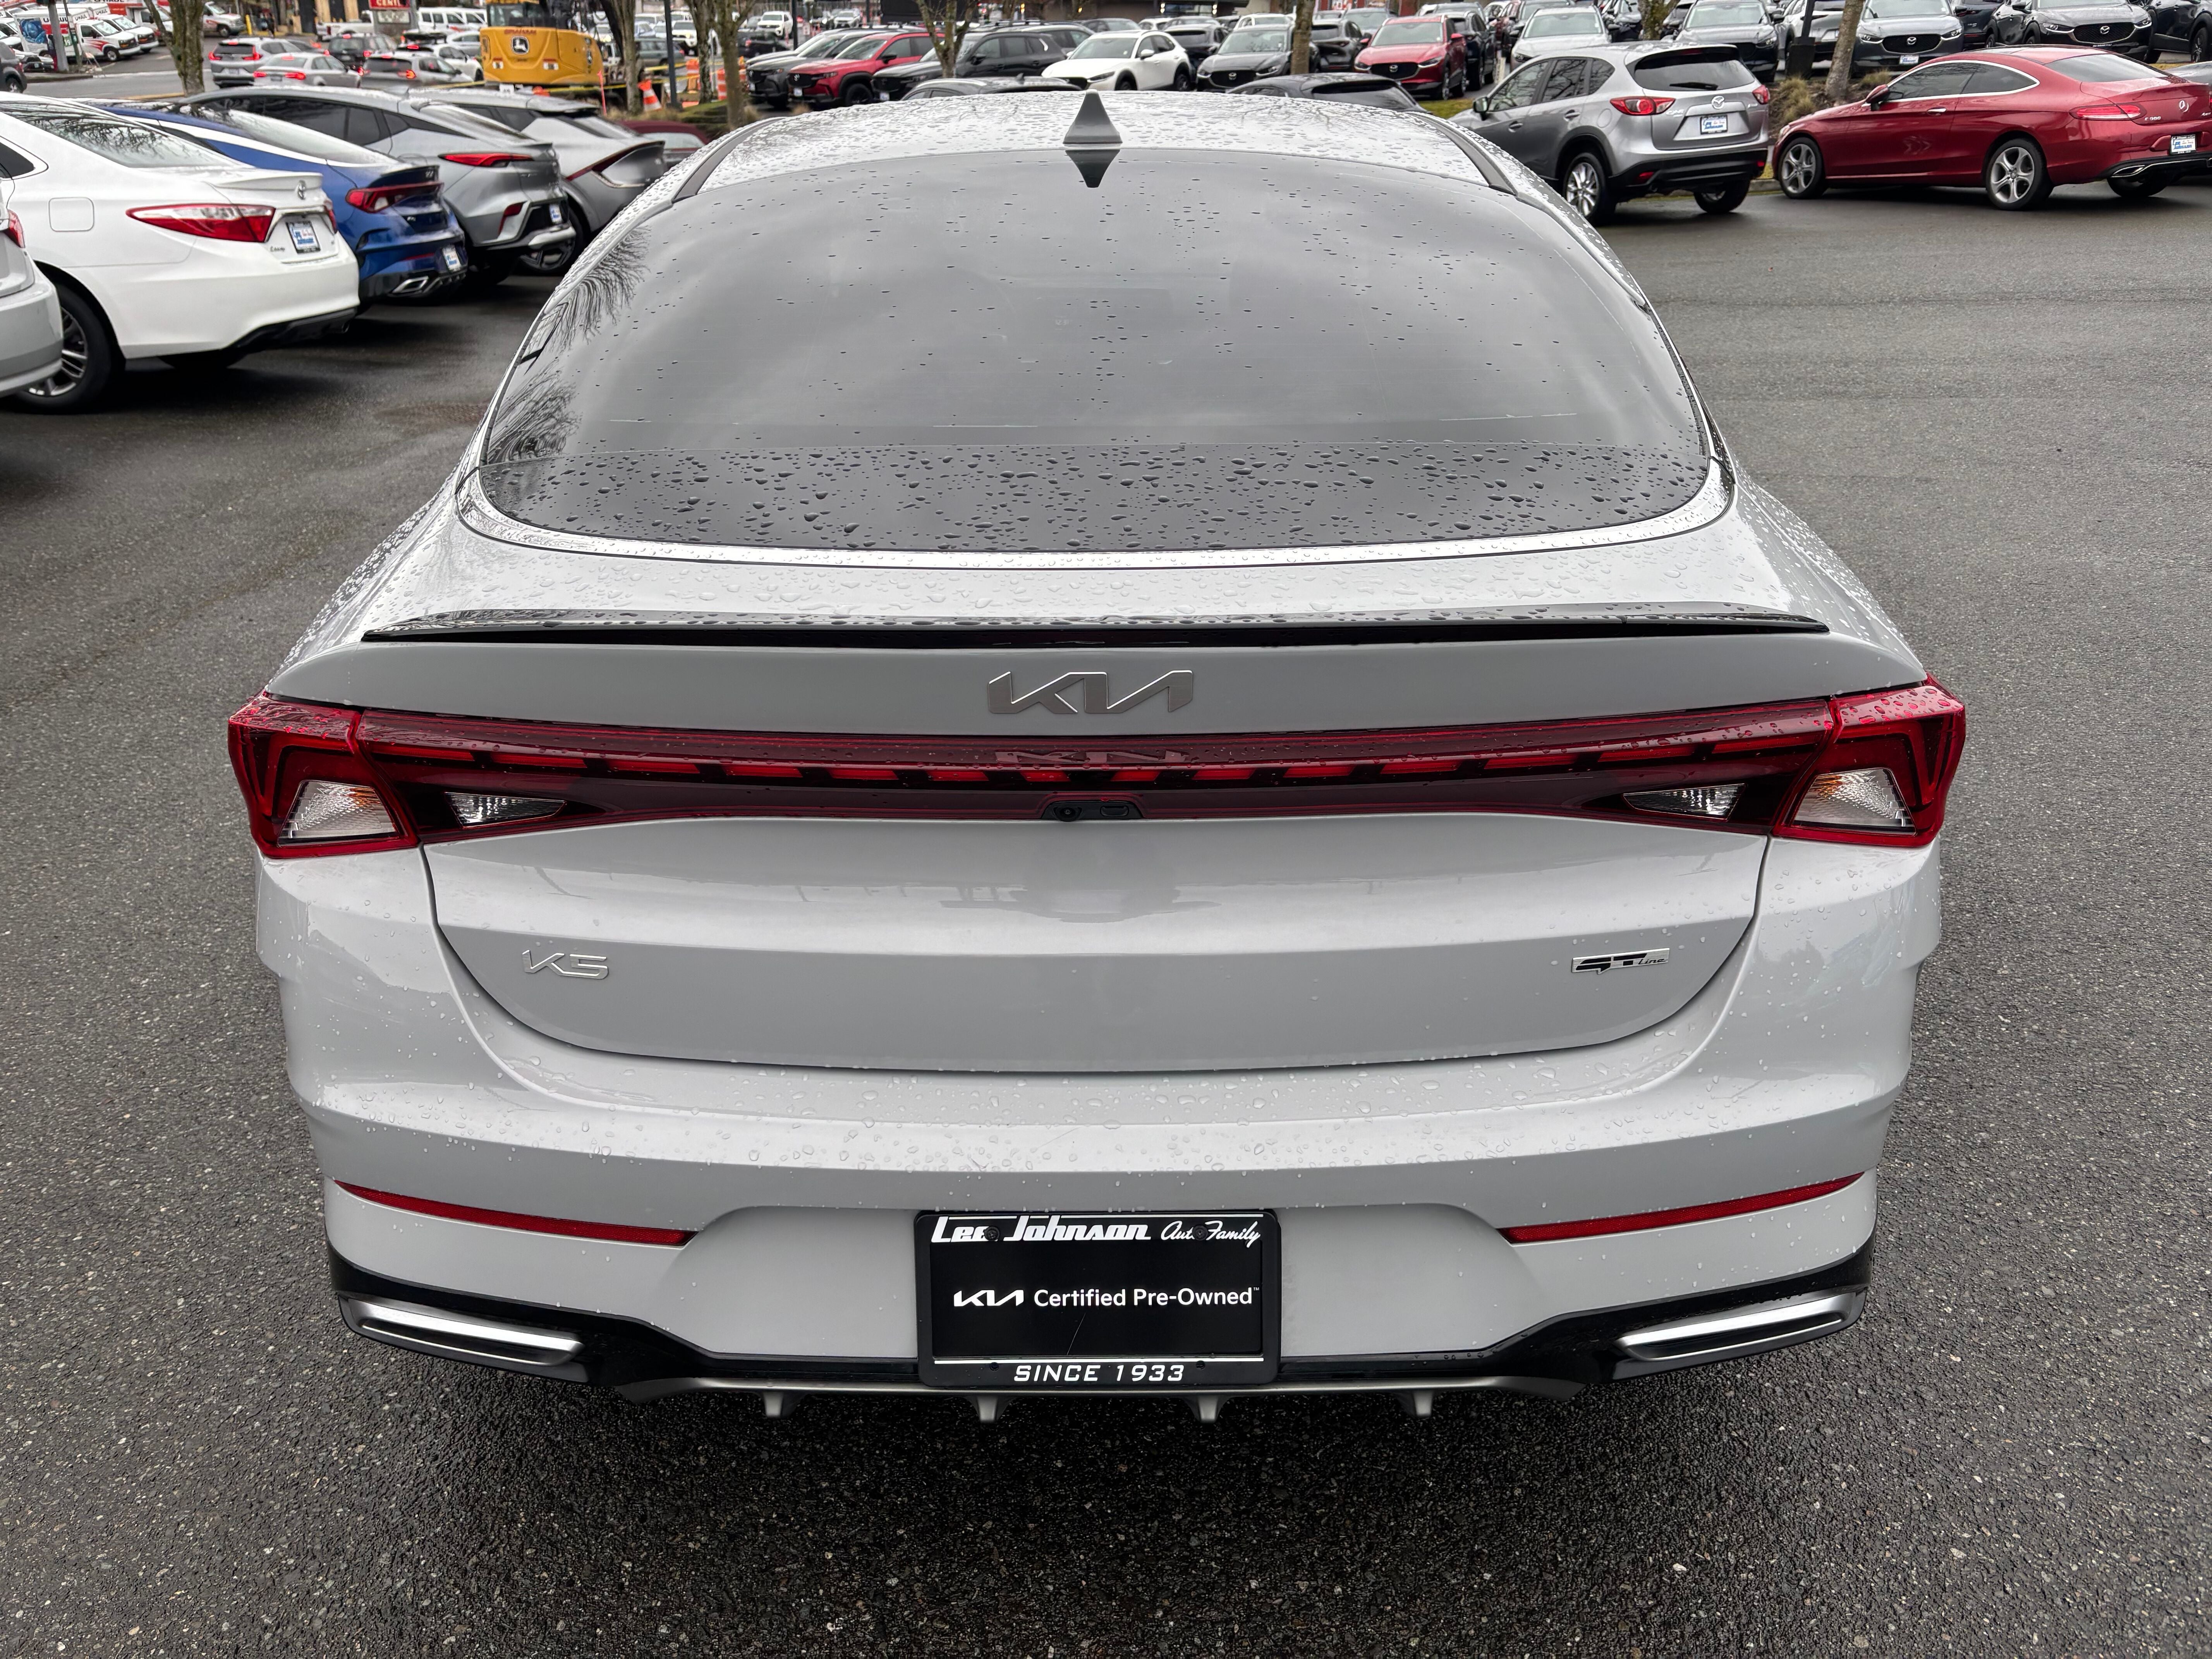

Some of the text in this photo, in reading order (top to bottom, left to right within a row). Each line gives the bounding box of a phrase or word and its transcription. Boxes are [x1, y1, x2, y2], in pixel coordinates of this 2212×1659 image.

[988, 670, 1193, 714] KIA
[522, 950, 609, 979] K5
[1003, 1215, 1151, 1241] Johnson
[1161, 1220, 1261, 1248] Aut Family
[954, 1290, 1024, 1307] KIA
[1034, 1288, 1126, 1307] Certified
[1133, 1287, 1252, 1306] Pre-Owned
[1014, 1364, 1184, 1382] SINCE 1933
